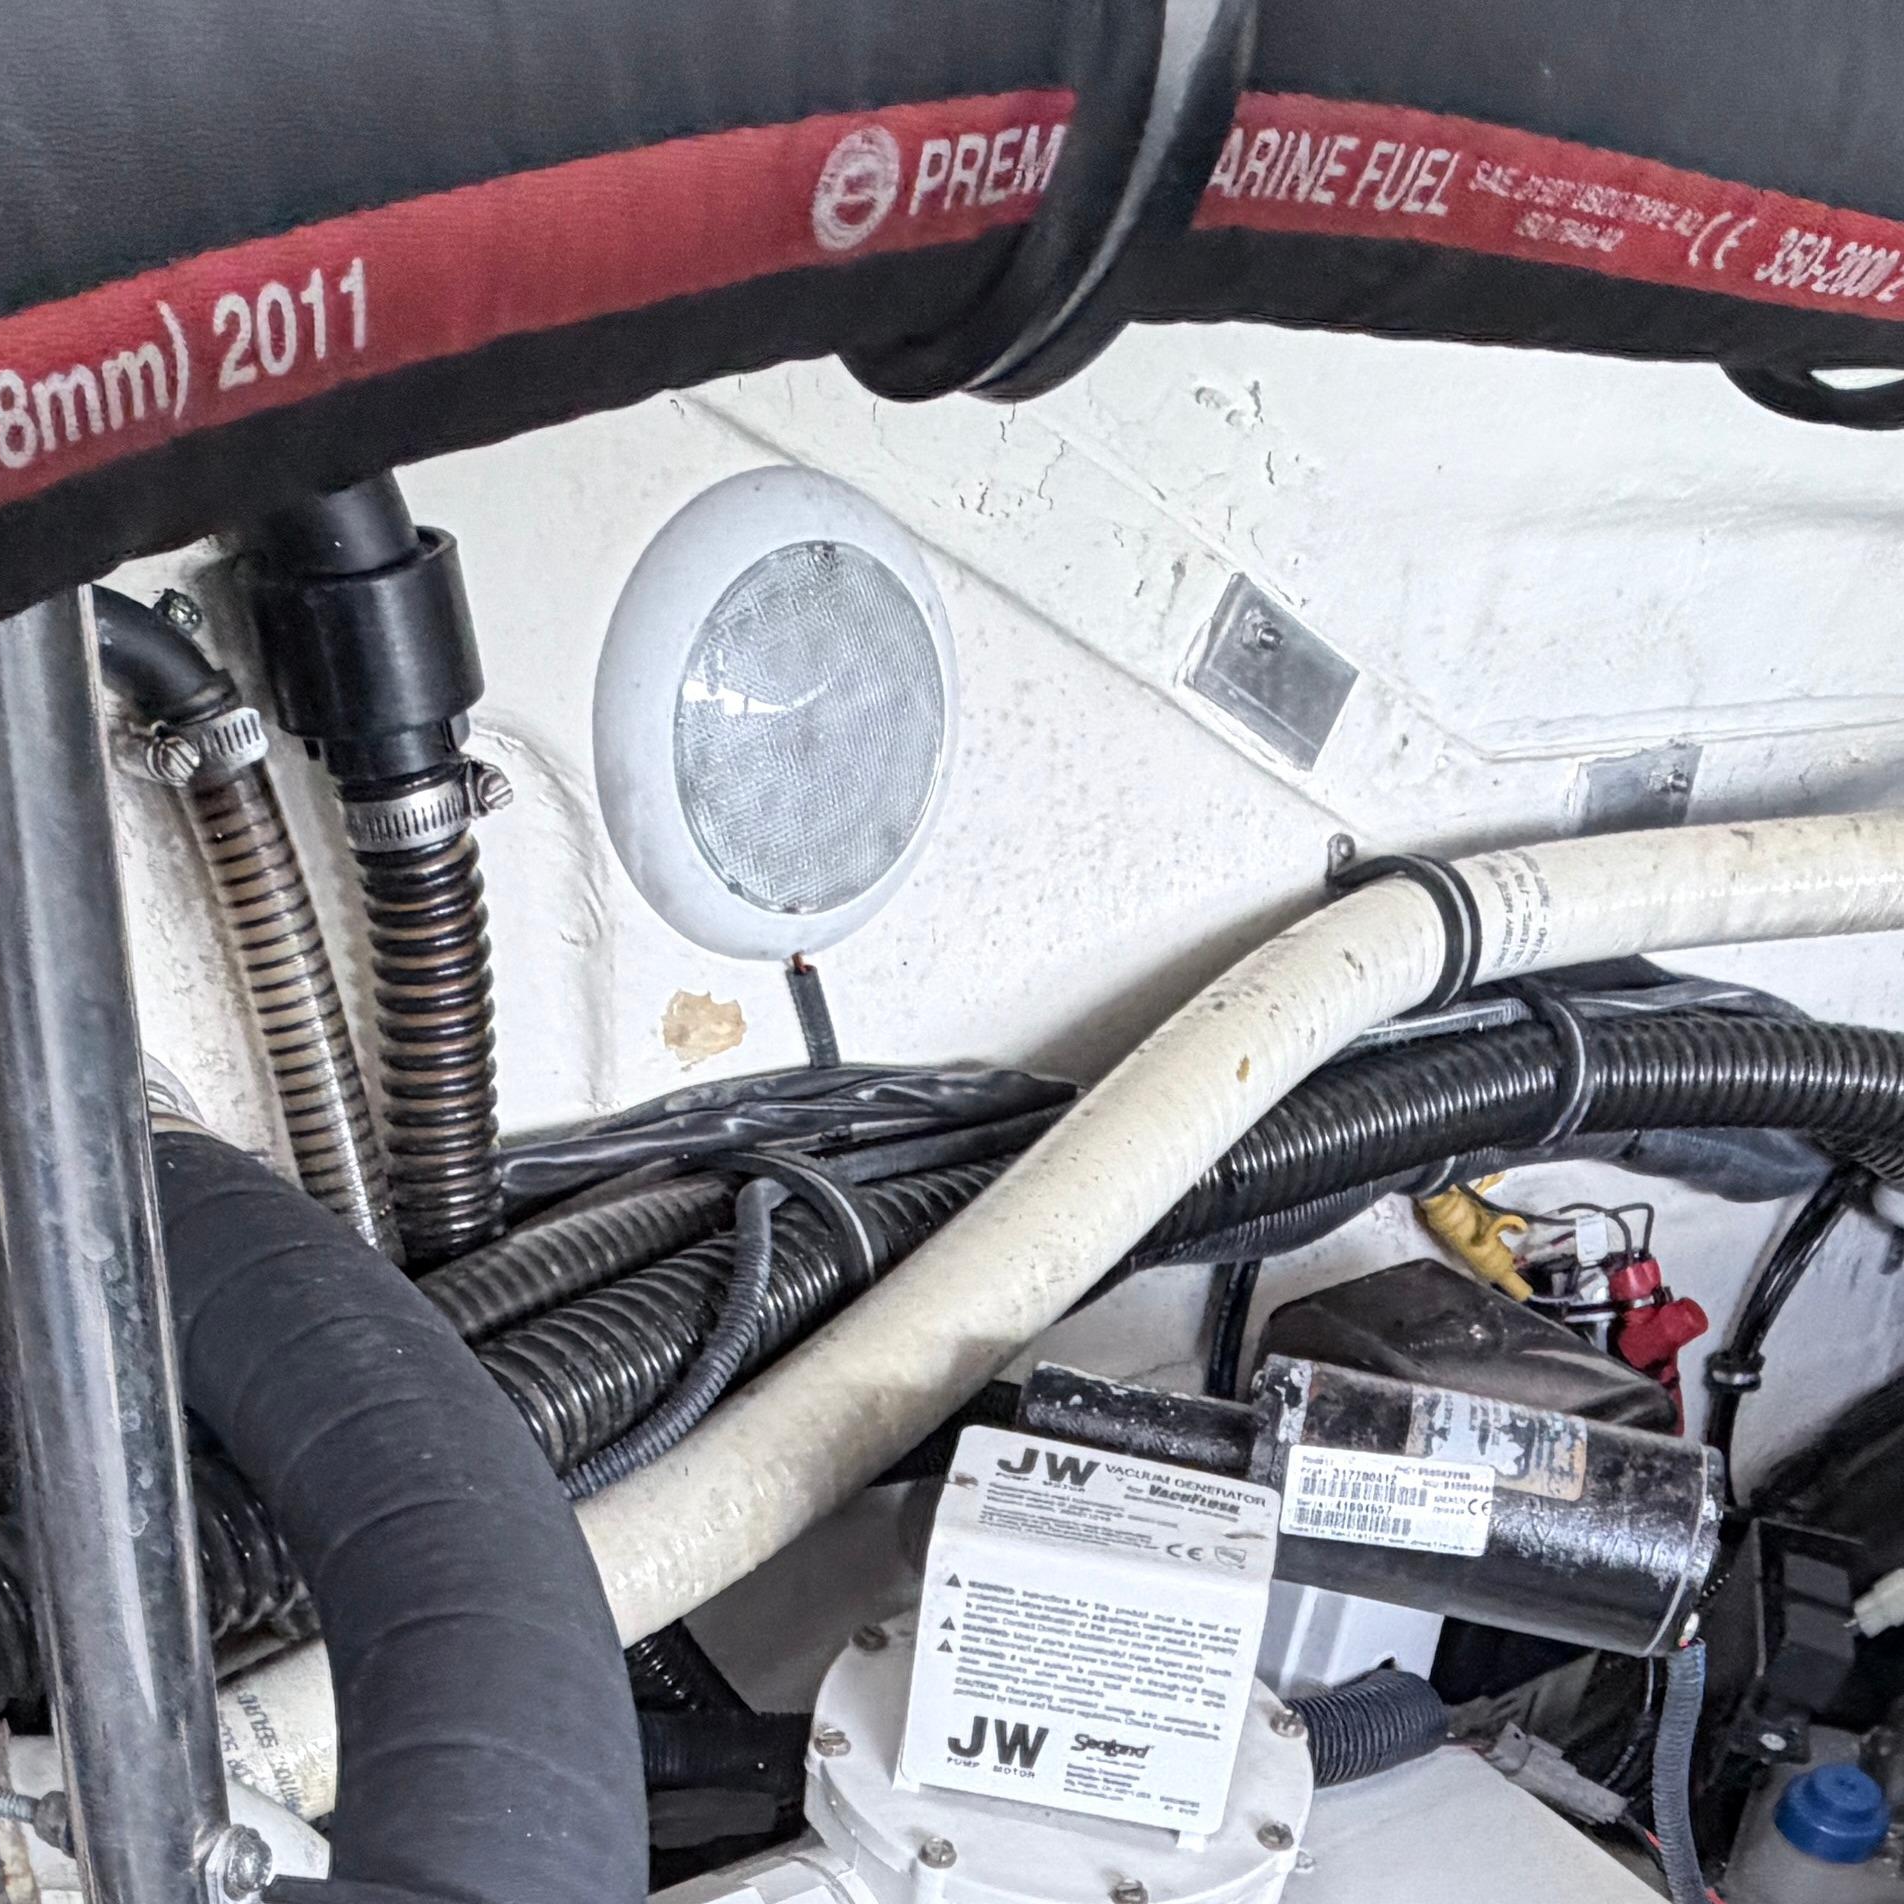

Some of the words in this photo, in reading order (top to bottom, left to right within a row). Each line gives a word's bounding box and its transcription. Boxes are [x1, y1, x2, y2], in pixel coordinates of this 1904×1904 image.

[908, 124, 1067, 216] PREM
[1210, 127, 1359, 205] ARINE
[1348, 140, 1461, 216] FUEL
[1753, 228, 1901, 301] 350-2000
[212, 257, 368, 393] 2011
[996, 1448, 1100, 1486] JW
[1104, 1463, 1170, 1486] VACUUM
[1175, 1479, 1266, 1507] GENERATOR
[948, 1715, 1049, 1769] JW
[993, 1765, 1035, 1779] MOTOR
